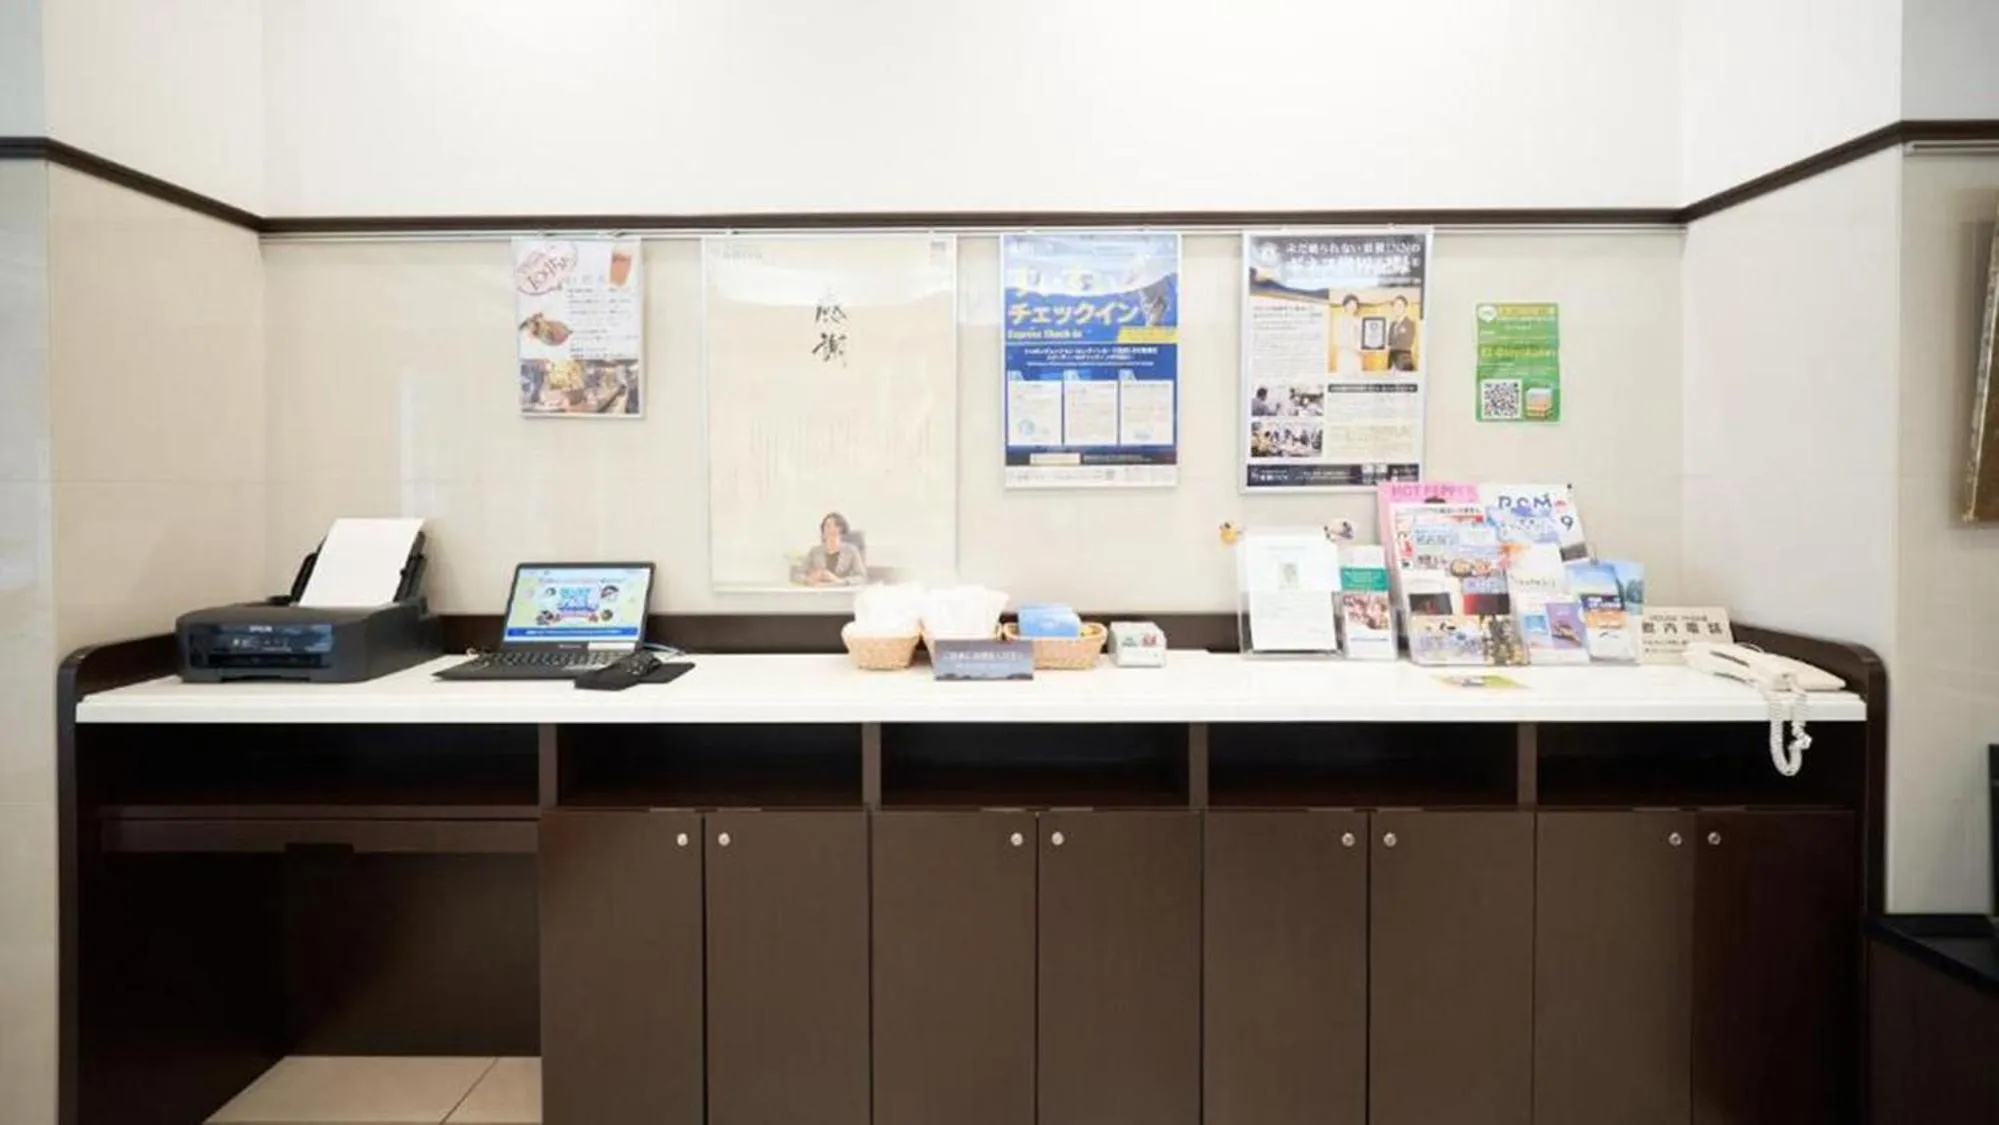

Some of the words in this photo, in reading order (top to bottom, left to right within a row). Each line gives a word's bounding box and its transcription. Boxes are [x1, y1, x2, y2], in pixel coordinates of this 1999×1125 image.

[1008, 300, 1139, 325] チェックイン
[1561, 515, 1575, 531] 9
